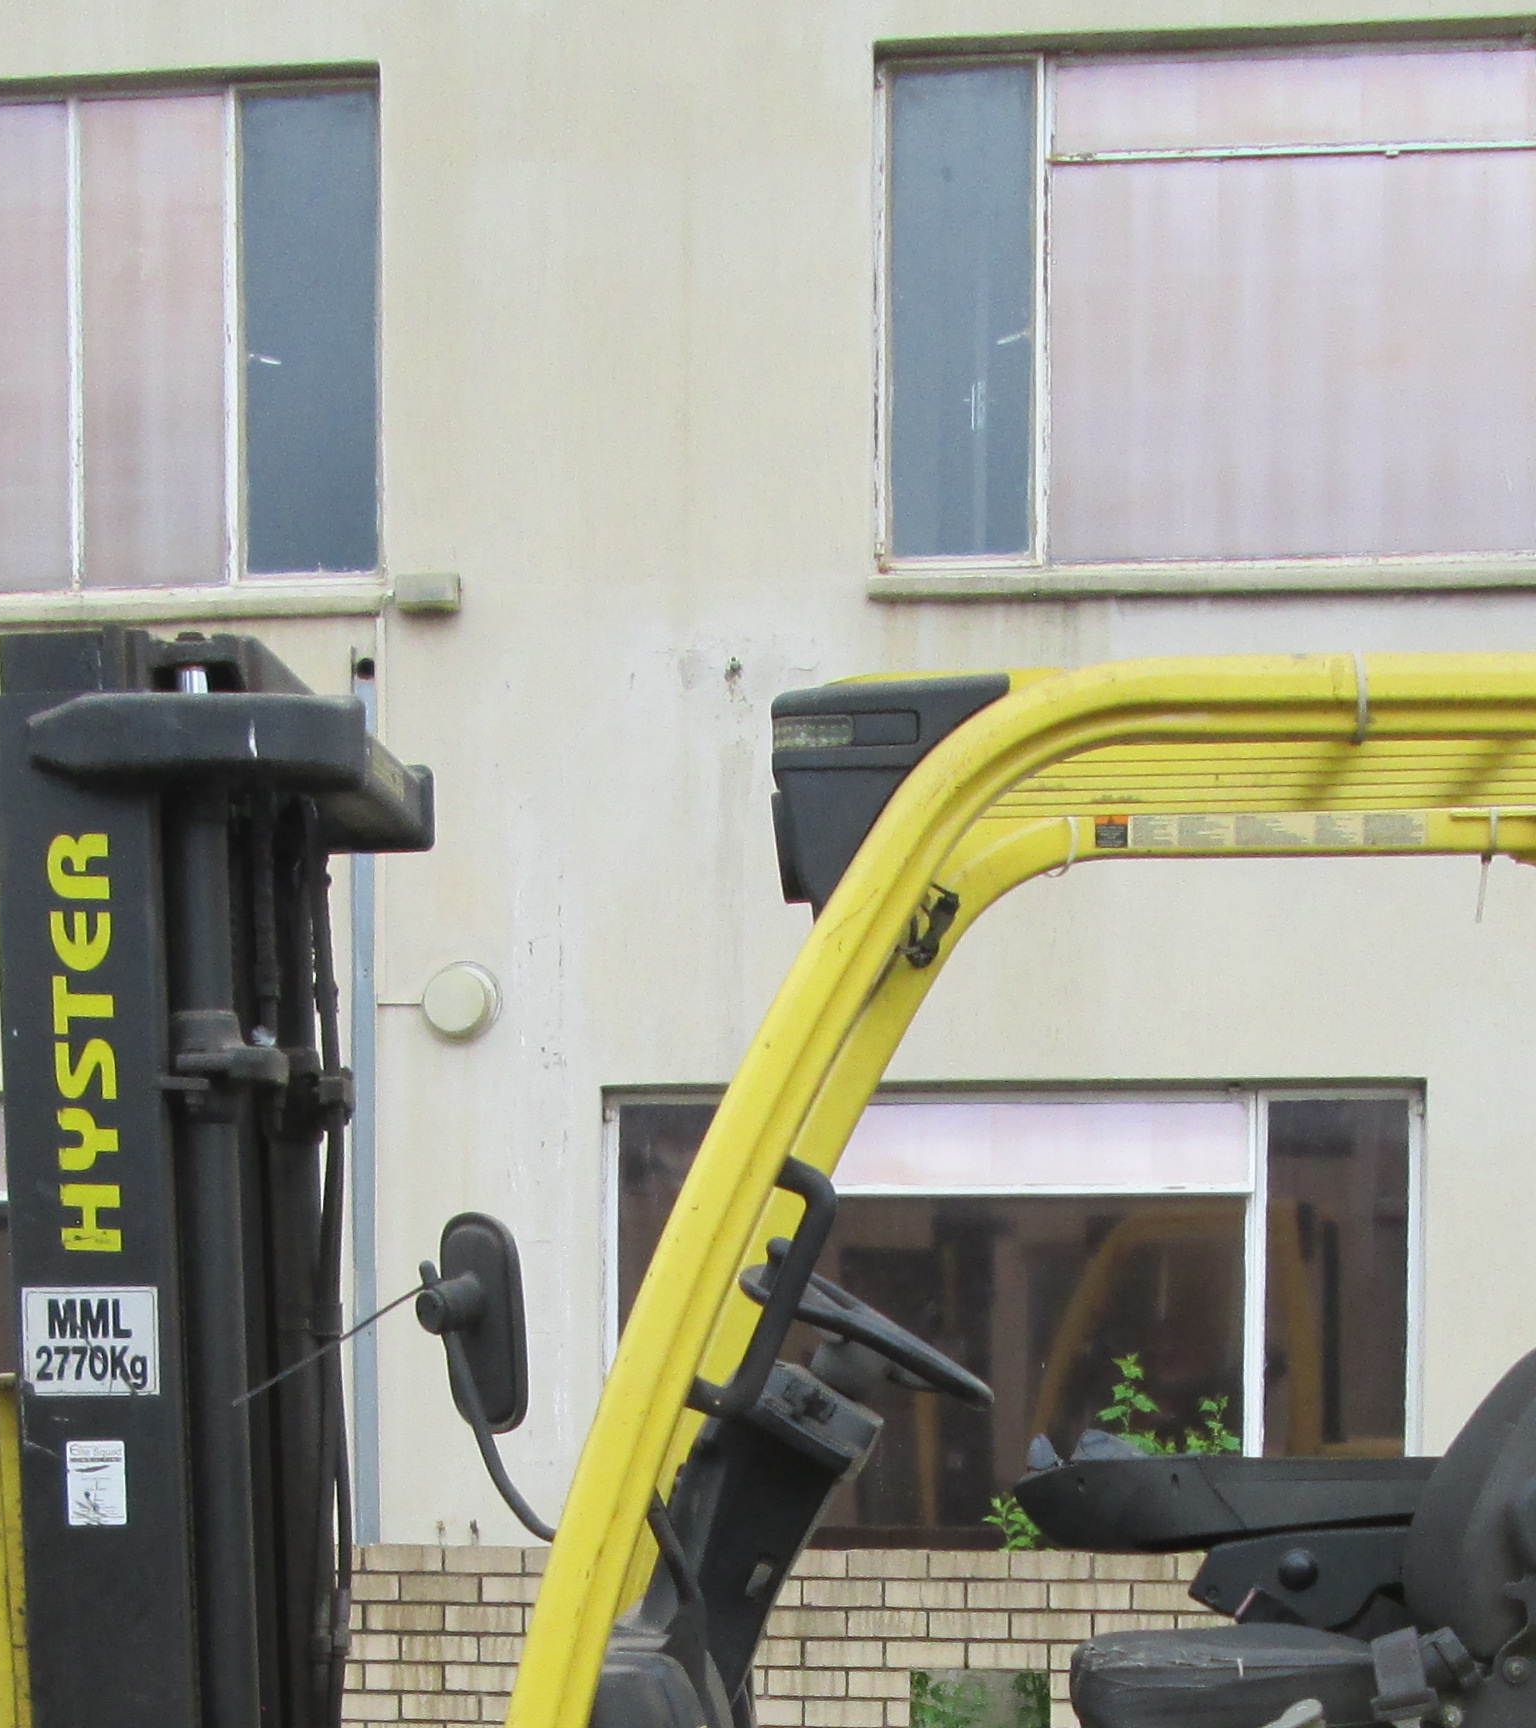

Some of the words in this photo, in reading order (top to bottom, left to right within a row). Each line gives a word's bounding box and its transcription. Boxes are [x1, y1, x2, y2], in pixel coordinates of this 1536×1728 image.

[47, 832, 122, 1252] HYSTER
[47, 1298, 133, 1339] MML
[35, 1345, 148, 1391] 2770Kg
